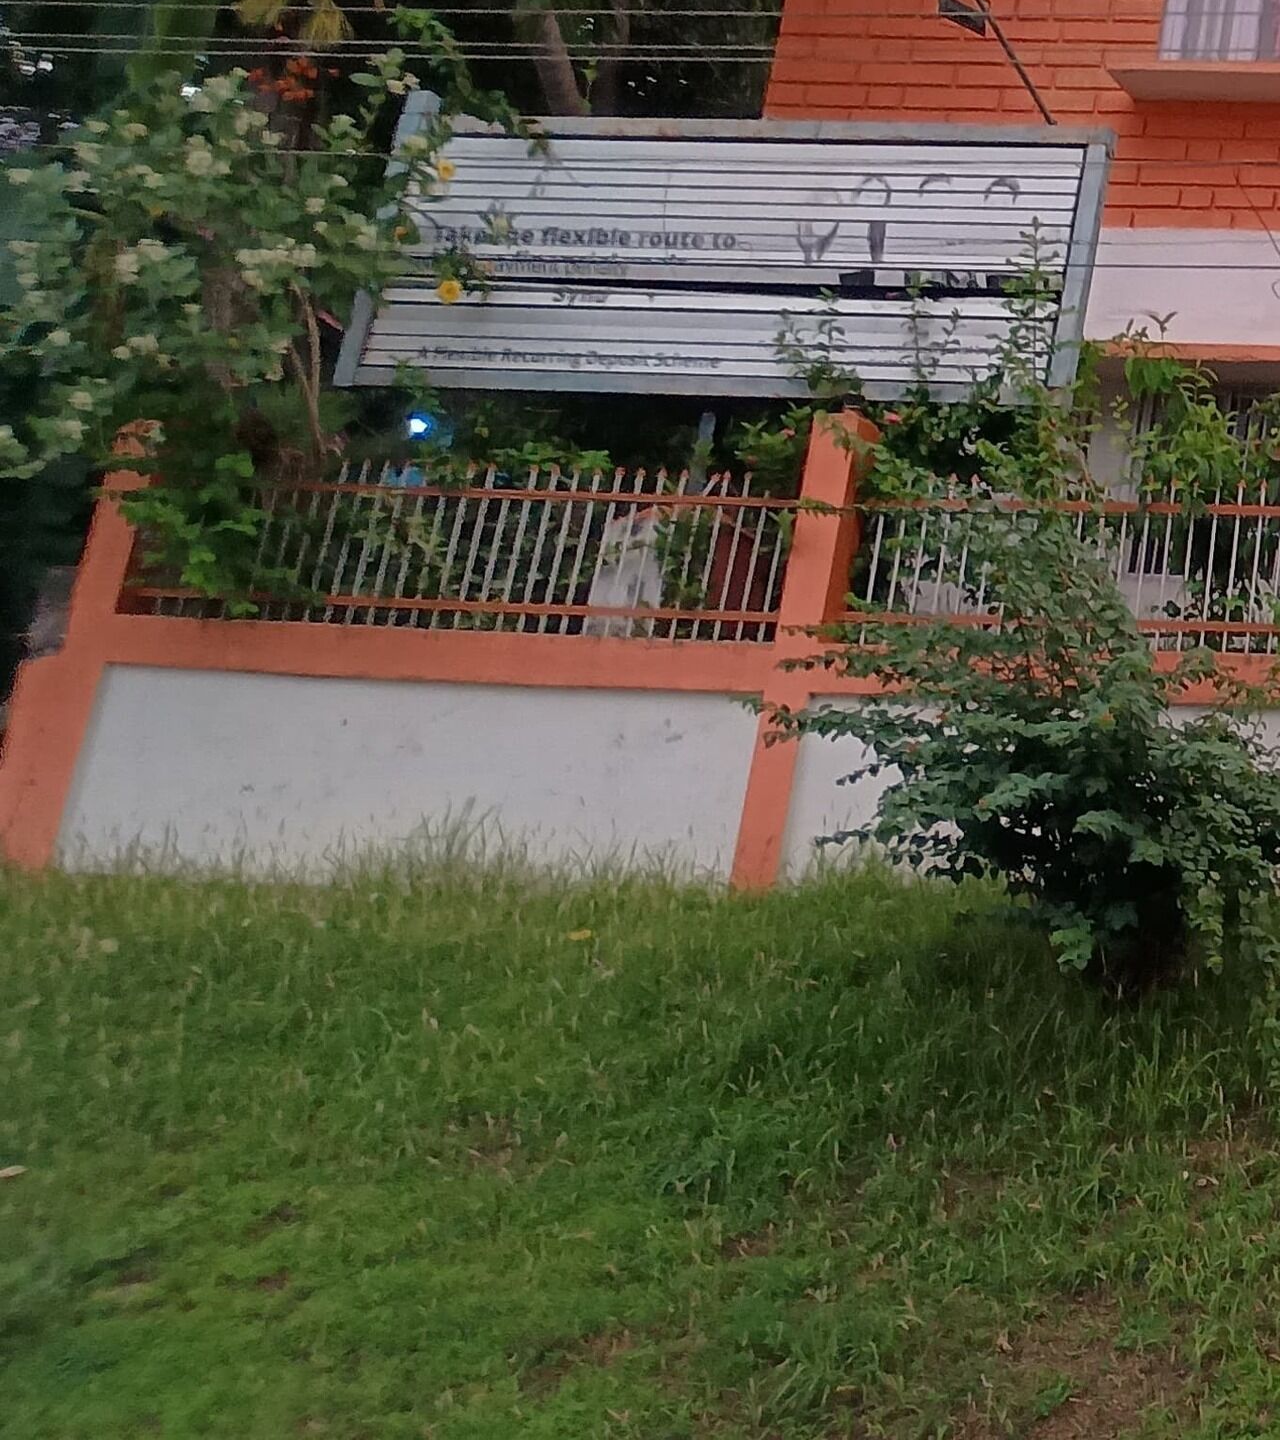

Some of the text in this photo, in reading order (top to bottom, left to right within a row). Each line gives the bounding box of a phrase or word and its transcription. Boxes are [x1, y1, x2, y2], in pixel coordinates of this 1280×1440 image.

[546, 225, 632, 247] flexible
[639, 229, 705, 249] route
[712, 231, 737, 250] to
